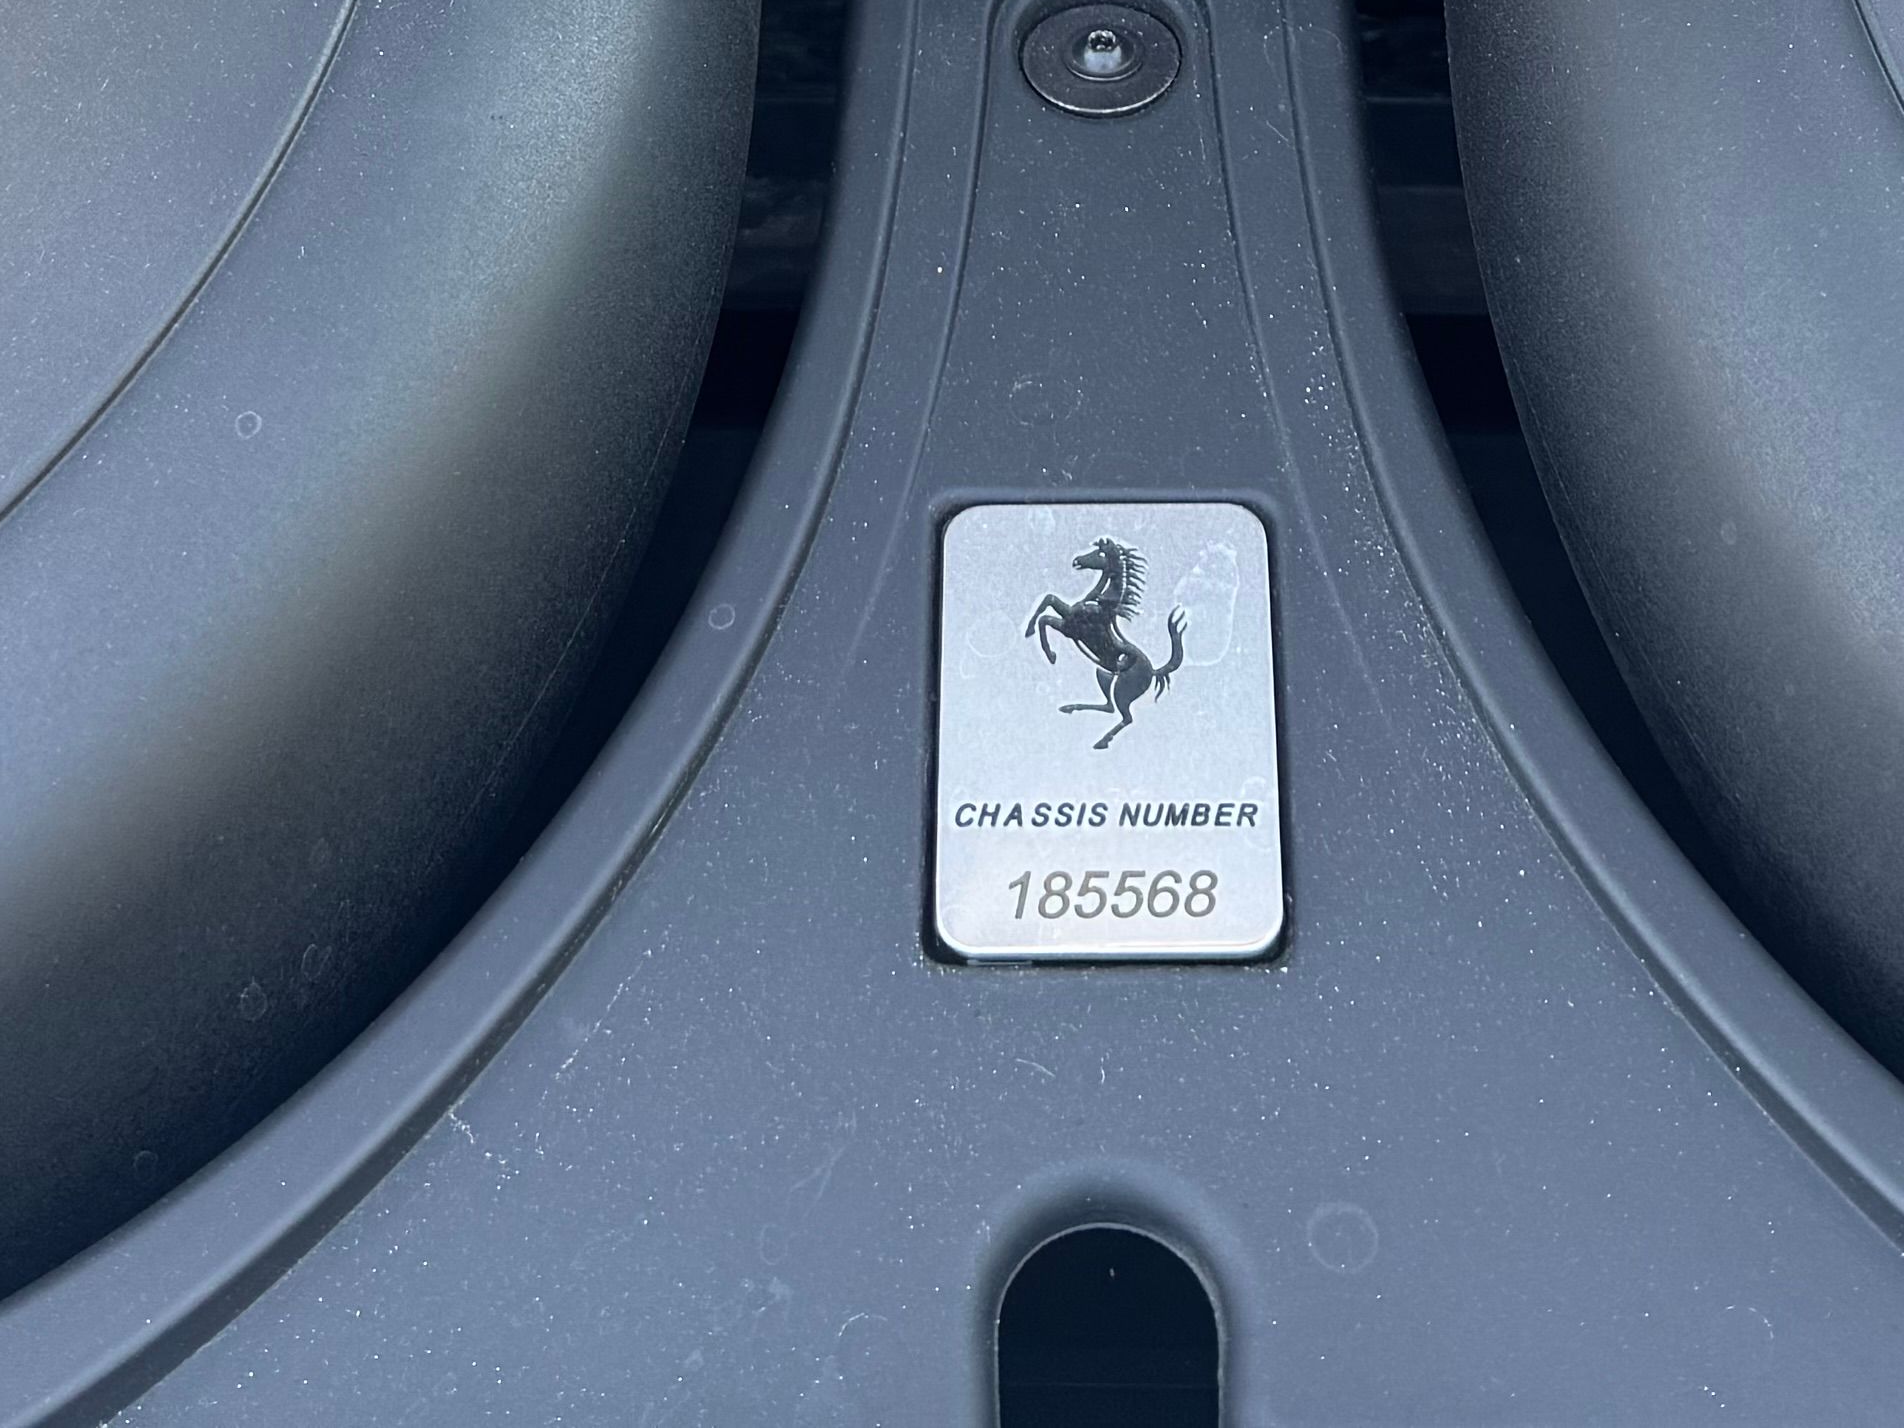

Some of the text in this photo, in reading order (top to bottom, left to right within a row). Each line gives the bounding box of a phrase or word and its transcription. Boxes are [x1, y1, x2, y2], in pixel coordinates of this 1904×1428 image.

[954, 802, 1260, 828] CHASSIS NUMBER
[1006, 869, 1219, 920] 185568
